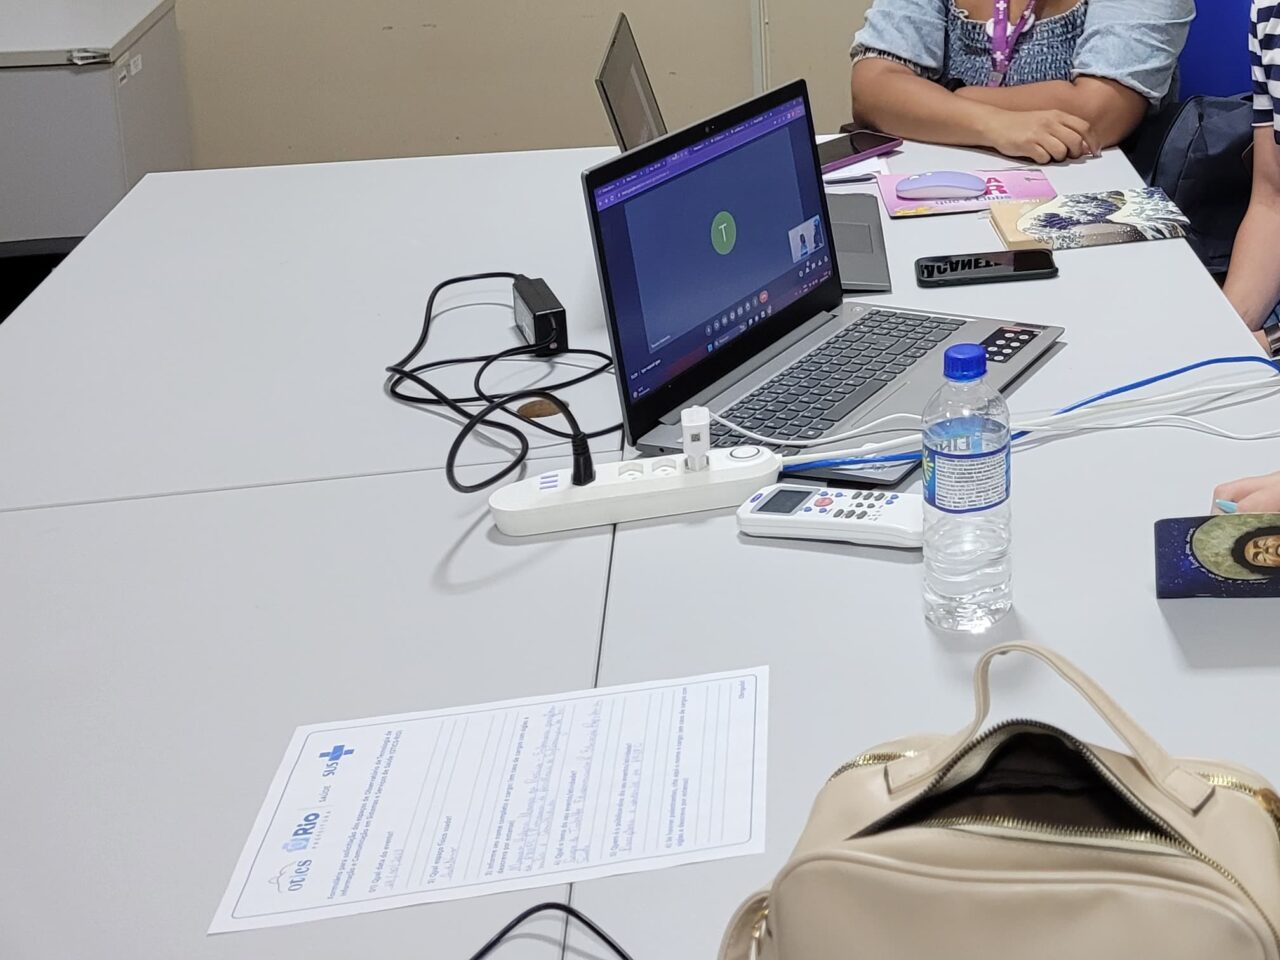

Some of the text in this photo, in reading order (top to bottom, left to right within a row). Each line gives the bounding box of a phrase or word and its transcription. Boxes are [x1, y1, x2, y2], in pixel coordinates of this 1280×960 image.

[718, 223, 728, 243] T
[322, 761, 339, 777] SUS
[318, 785, 331, 803] SAÚDE
[292, 812, 320, 836] Rio
